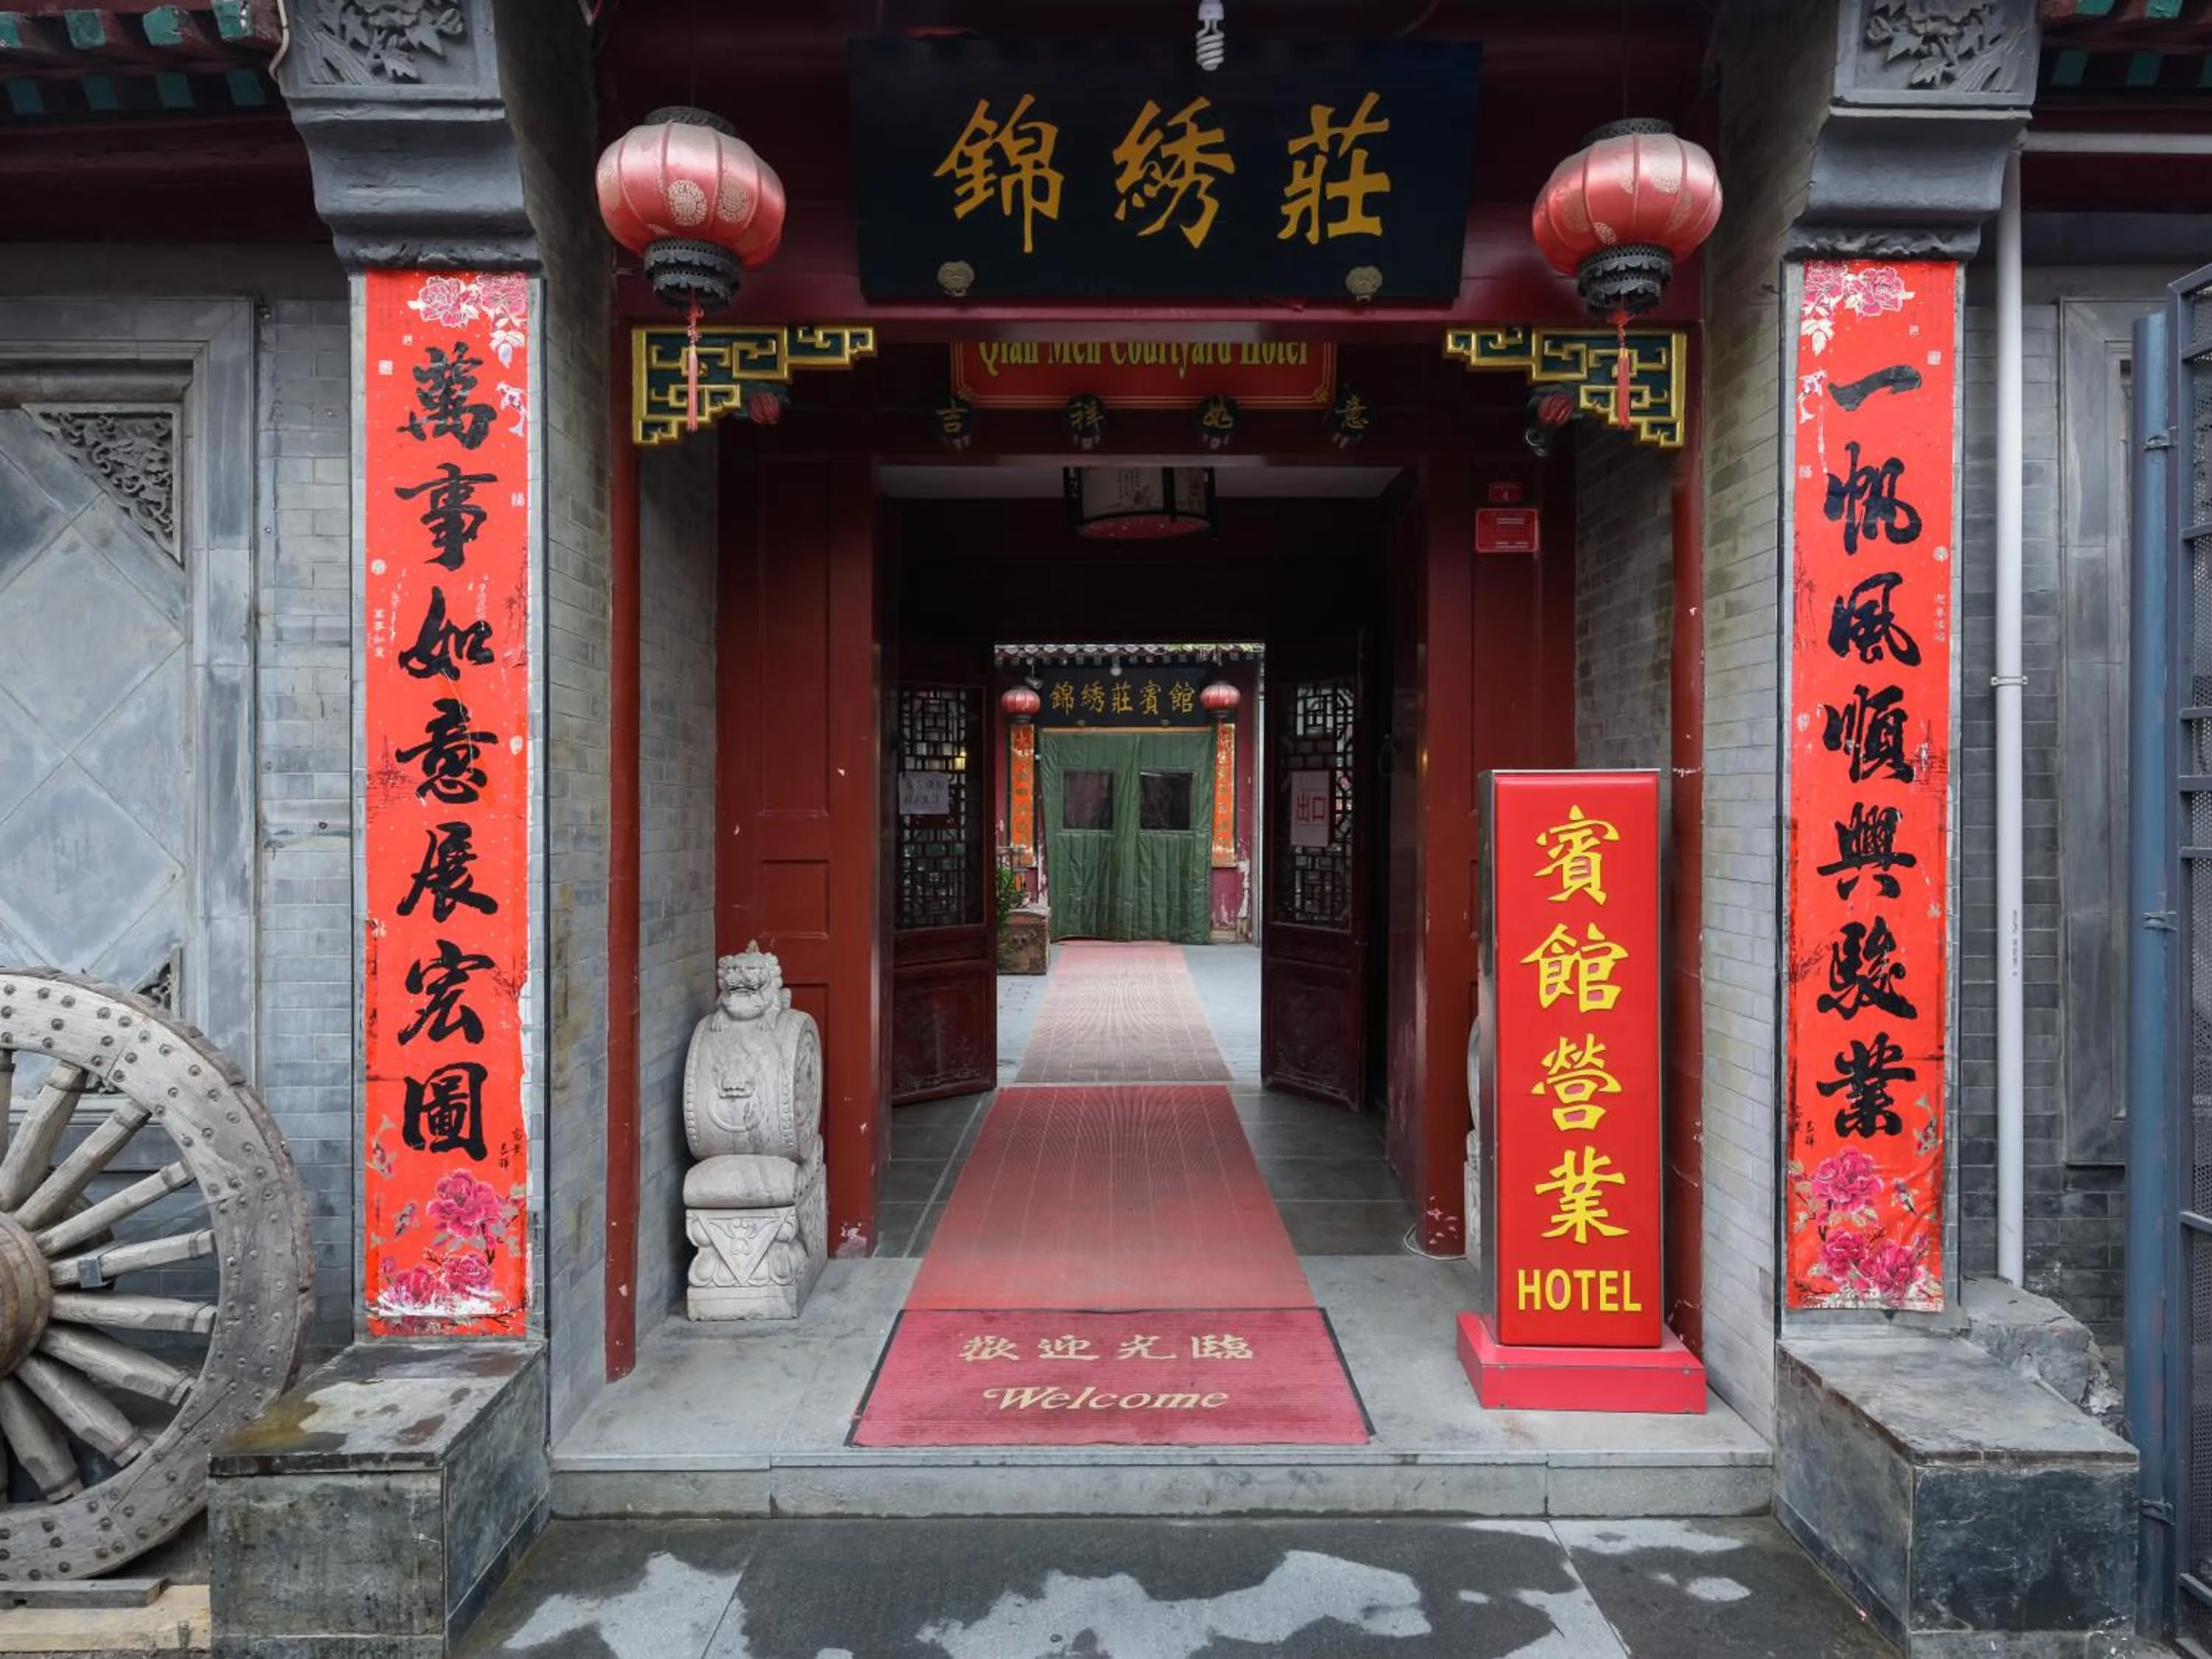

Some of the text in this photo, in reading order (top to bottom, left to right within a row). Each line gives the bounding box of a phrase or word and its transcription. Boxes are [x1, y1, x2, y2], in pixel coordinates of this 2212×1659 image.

[394, 341, 498, 1161] 萬事如意展宏圖
[1520, 805, 1630, 1244] 賓館營業
[983, 1386, 1229, 1410] Welcome
[1517, 1269, 1643, 1312] HOTEL
